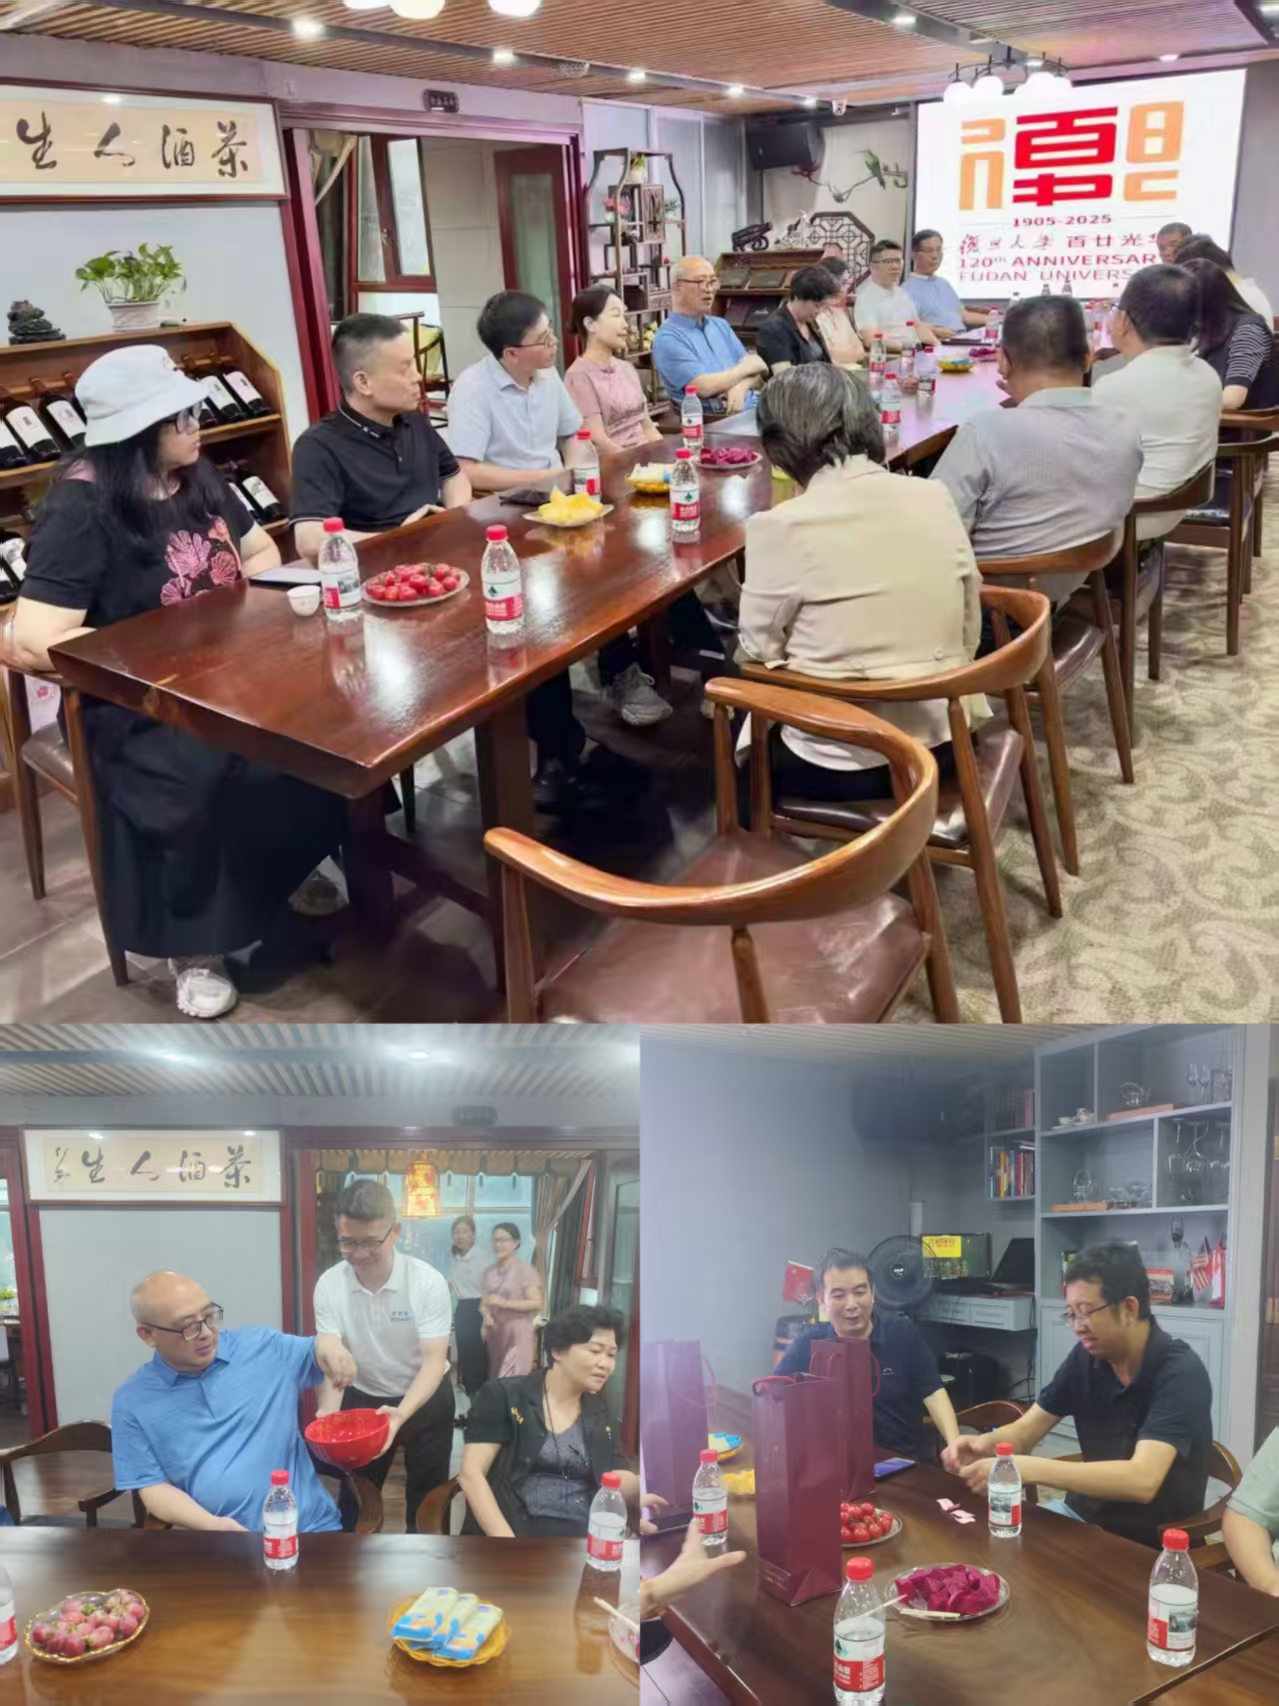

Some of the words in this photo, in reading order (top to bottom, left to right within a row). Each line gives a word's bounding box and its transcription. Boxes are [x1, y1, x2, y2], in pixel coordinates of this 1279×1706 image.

[1012, 214, 1112, 228] 1905-2025
[960, 256, 1006, 268] 120th
[1012, 253, 1157, 267] ANNIVERSAR
[960, 271, 1028, 281] FUDAN
[1040, 269, 1132, 281] UNIVERS
